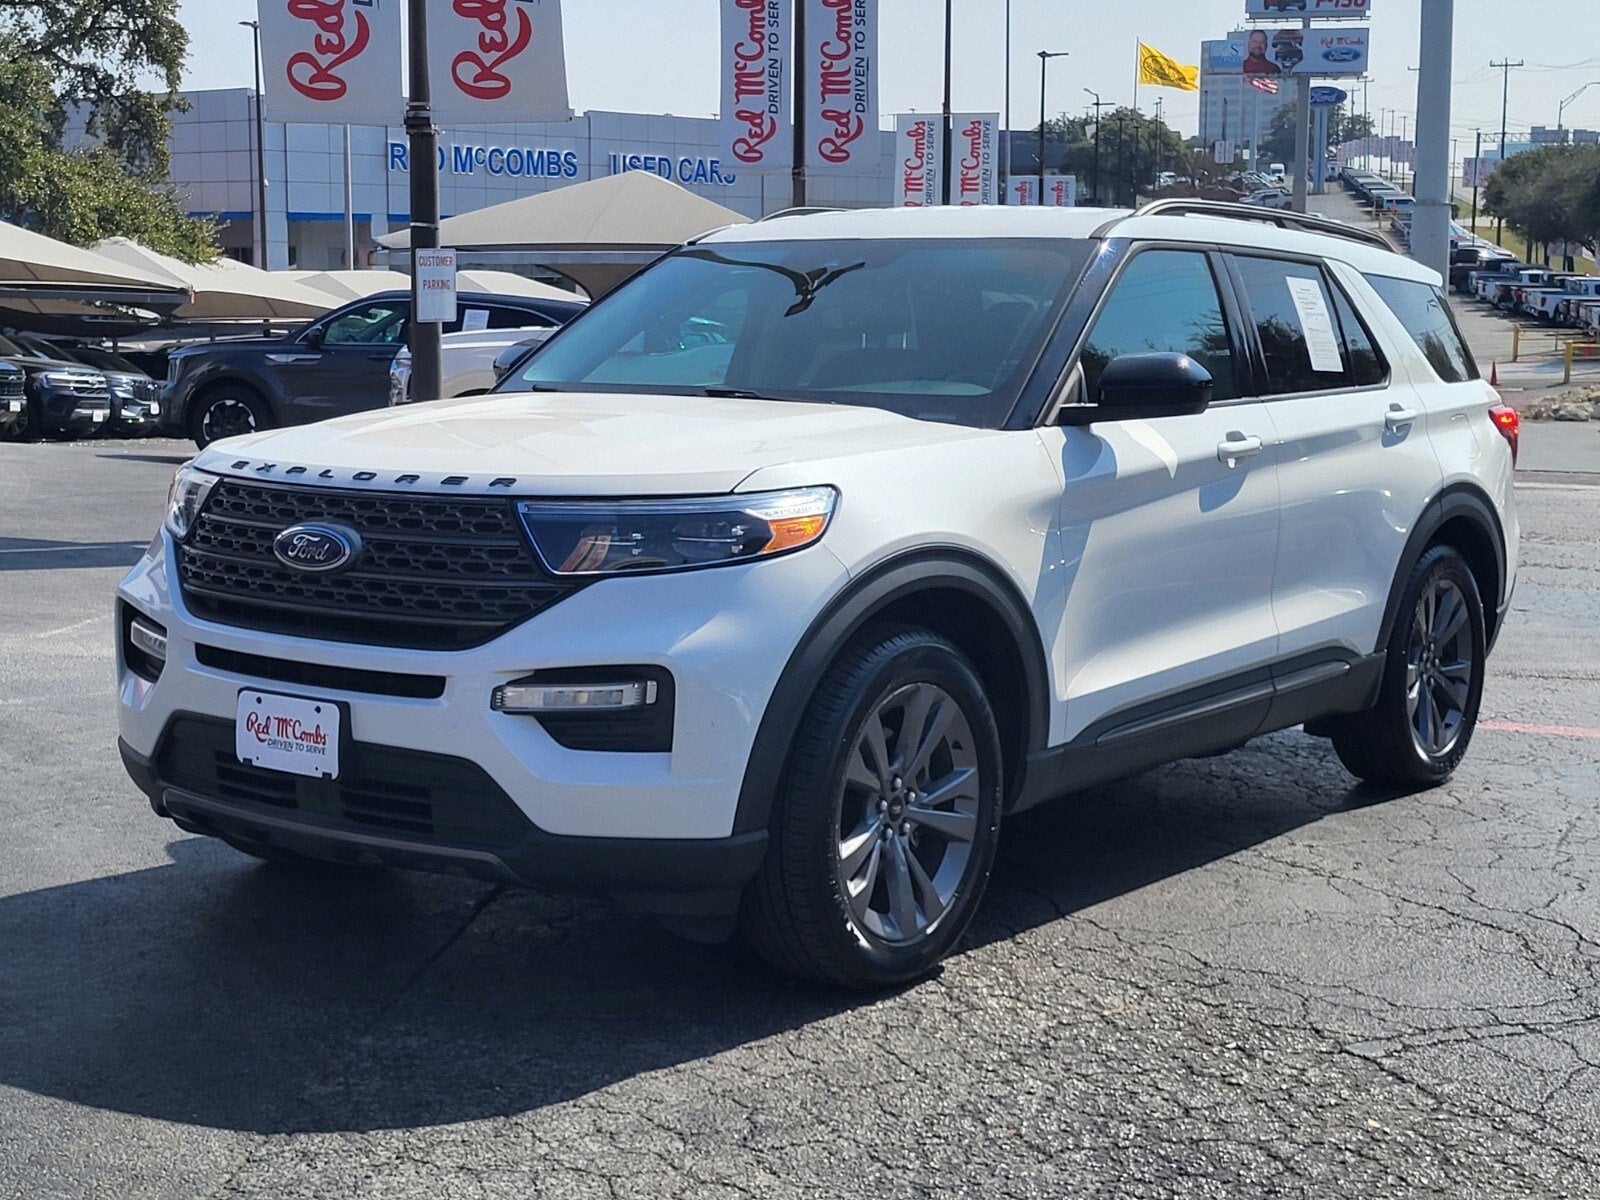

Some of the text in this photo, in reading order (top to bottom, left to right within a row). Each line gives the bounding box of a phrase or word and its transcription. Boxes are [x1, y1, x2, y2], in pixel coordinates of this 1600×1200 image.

[768, 32, 779, 53] TO
[855, 31, 866, 52] TO
[768, 58, 780, 114] DRIVEN
[855, 56, 867, 113] DRIVEN
[732, 109, 777, 163] Red
[818, 109, 864, 163] Red
[610, 153, 672, 181] USED
[904, 120, 926, 198] McCombs
[925, 120, 935, 205] DRIVEN TO SERVE
[961, 120, 982, 198] McCombs
[981, 120, 991, 205] DRIVEN TO SERVE
[418, 256, 454, 267] CUSTOMER
[422, 279, 451, 290] PARKING
[230, 460, 517, 488] EXPLORER
[287, 534, 330, 562] Ford
[246, 711, 327, 746] Red McCombs
[267, 738, 327, 756] DRIVEN TO SERVE
